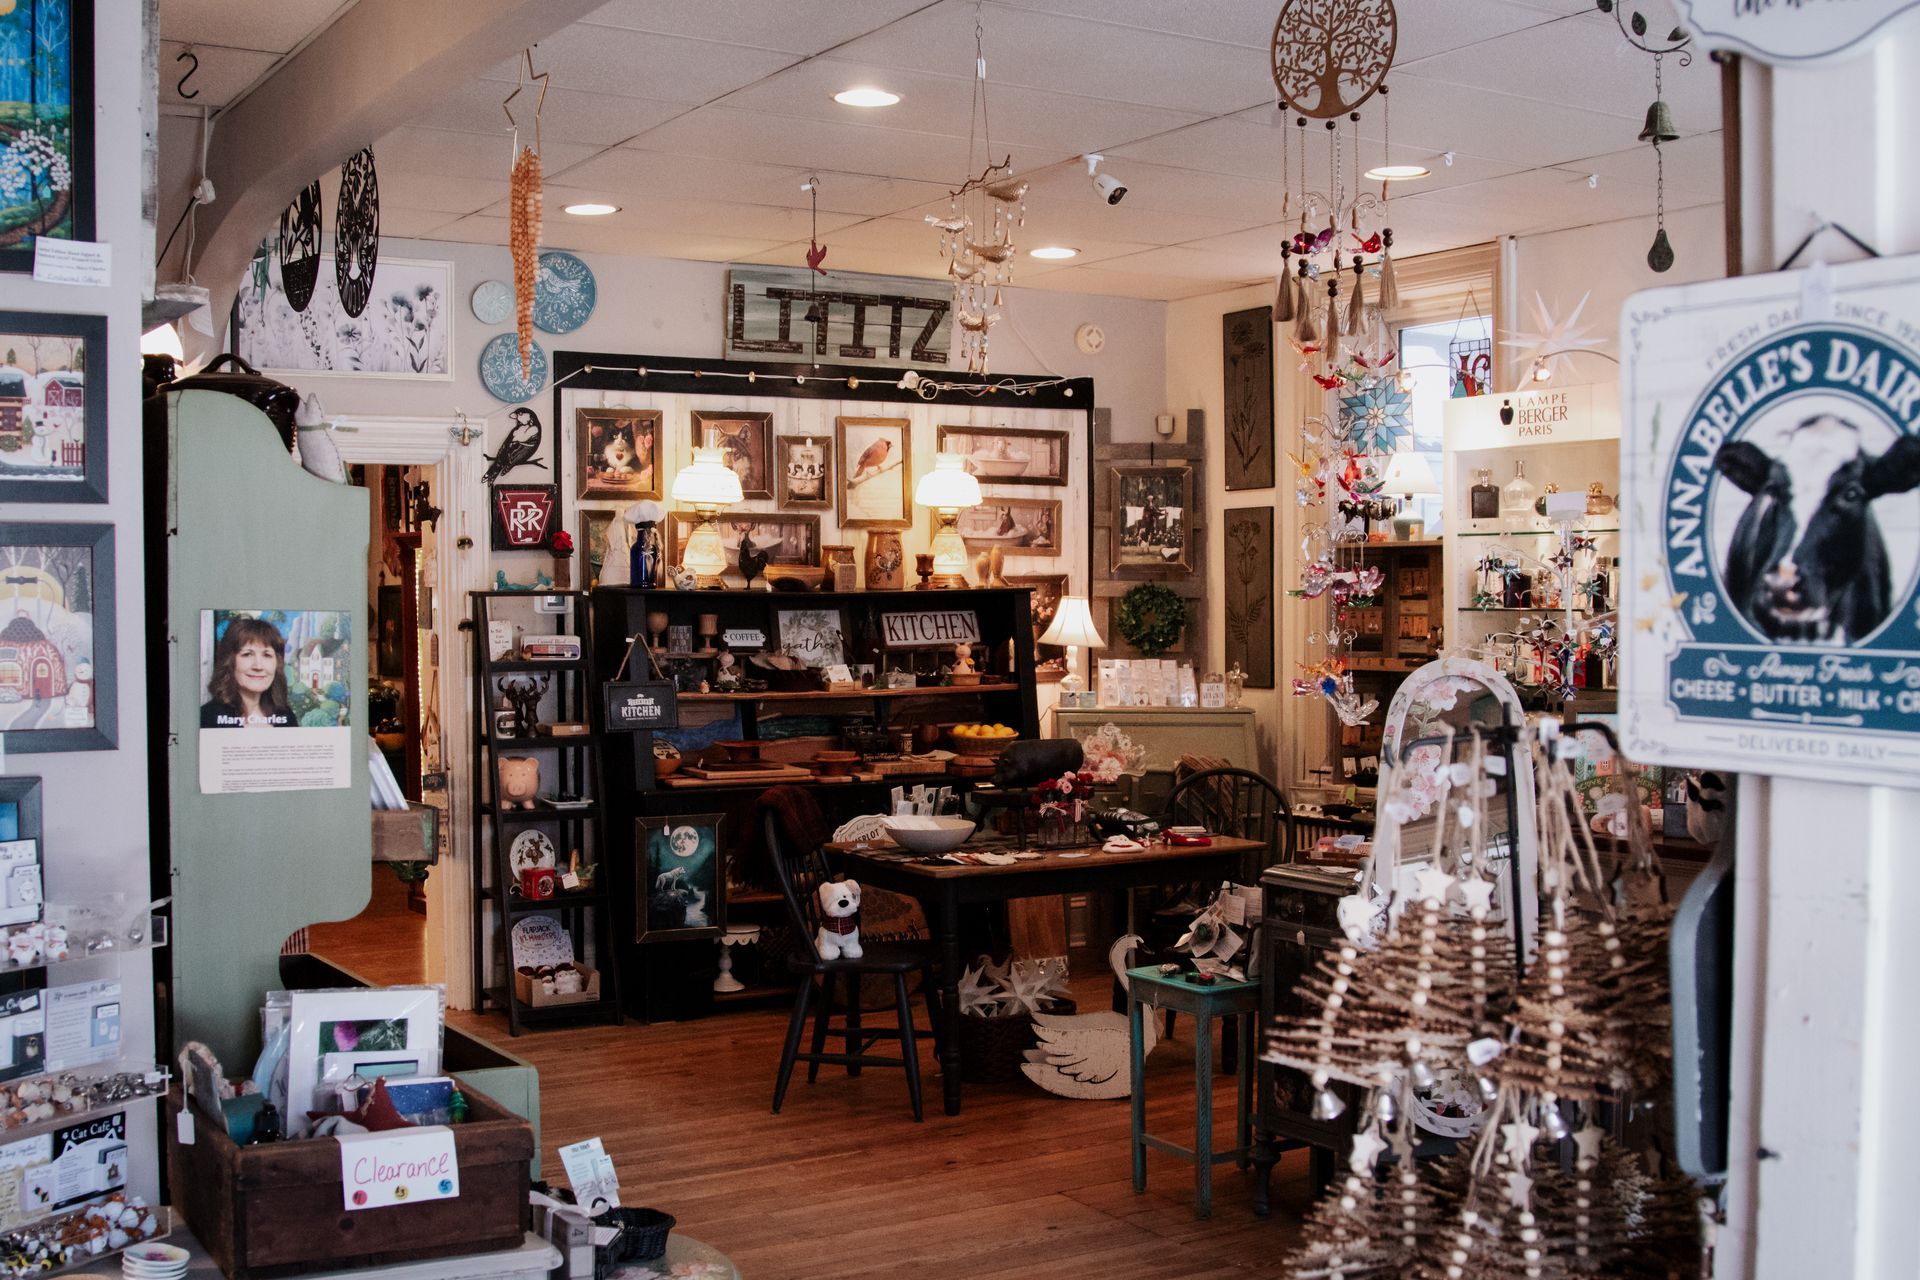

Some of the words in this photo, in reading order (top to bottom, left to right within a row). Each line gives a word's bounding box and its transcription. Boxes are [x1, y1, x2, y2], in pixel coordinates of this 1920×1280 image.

[1706, 323, 1761, 371] FRESH
[1767, 308, 1801, 329] DAI
[1834, 302, 1889, 326] SINCE
[1518, 393, 1568, 408] LAMPE
[1518, 406, 1568, 425] BERGER
[1518, 424, 1553, 437] PARIS
[1668, 339, 1814, 577] ANNABELLE'S
[729, 632, 761, 642] COFFEE
[885, 613, 977, 642] KITCHEN
[782, 632, 838, 657] gather
[1746, 652, 1816, 684] Always
[1817, 654, 1874, 684] Fresh
[1672, 678, 1736, 702] CHEESE
[1751, 682, 1822, 708] BUTTER
[1837, 688, 1881, 711] MILK
[217, 714, 245, 727] Mary
[247, 713, 288, 725] Charles
[621, 705, 662, 718] KITCHEN
[1738, 734, 1830, 757] DELIVERED
[1837, 741, 1888, 760] DAILY
[70, 1128, 88, 1141] Cat
[353, 1152, 449, 1185] Clearance
